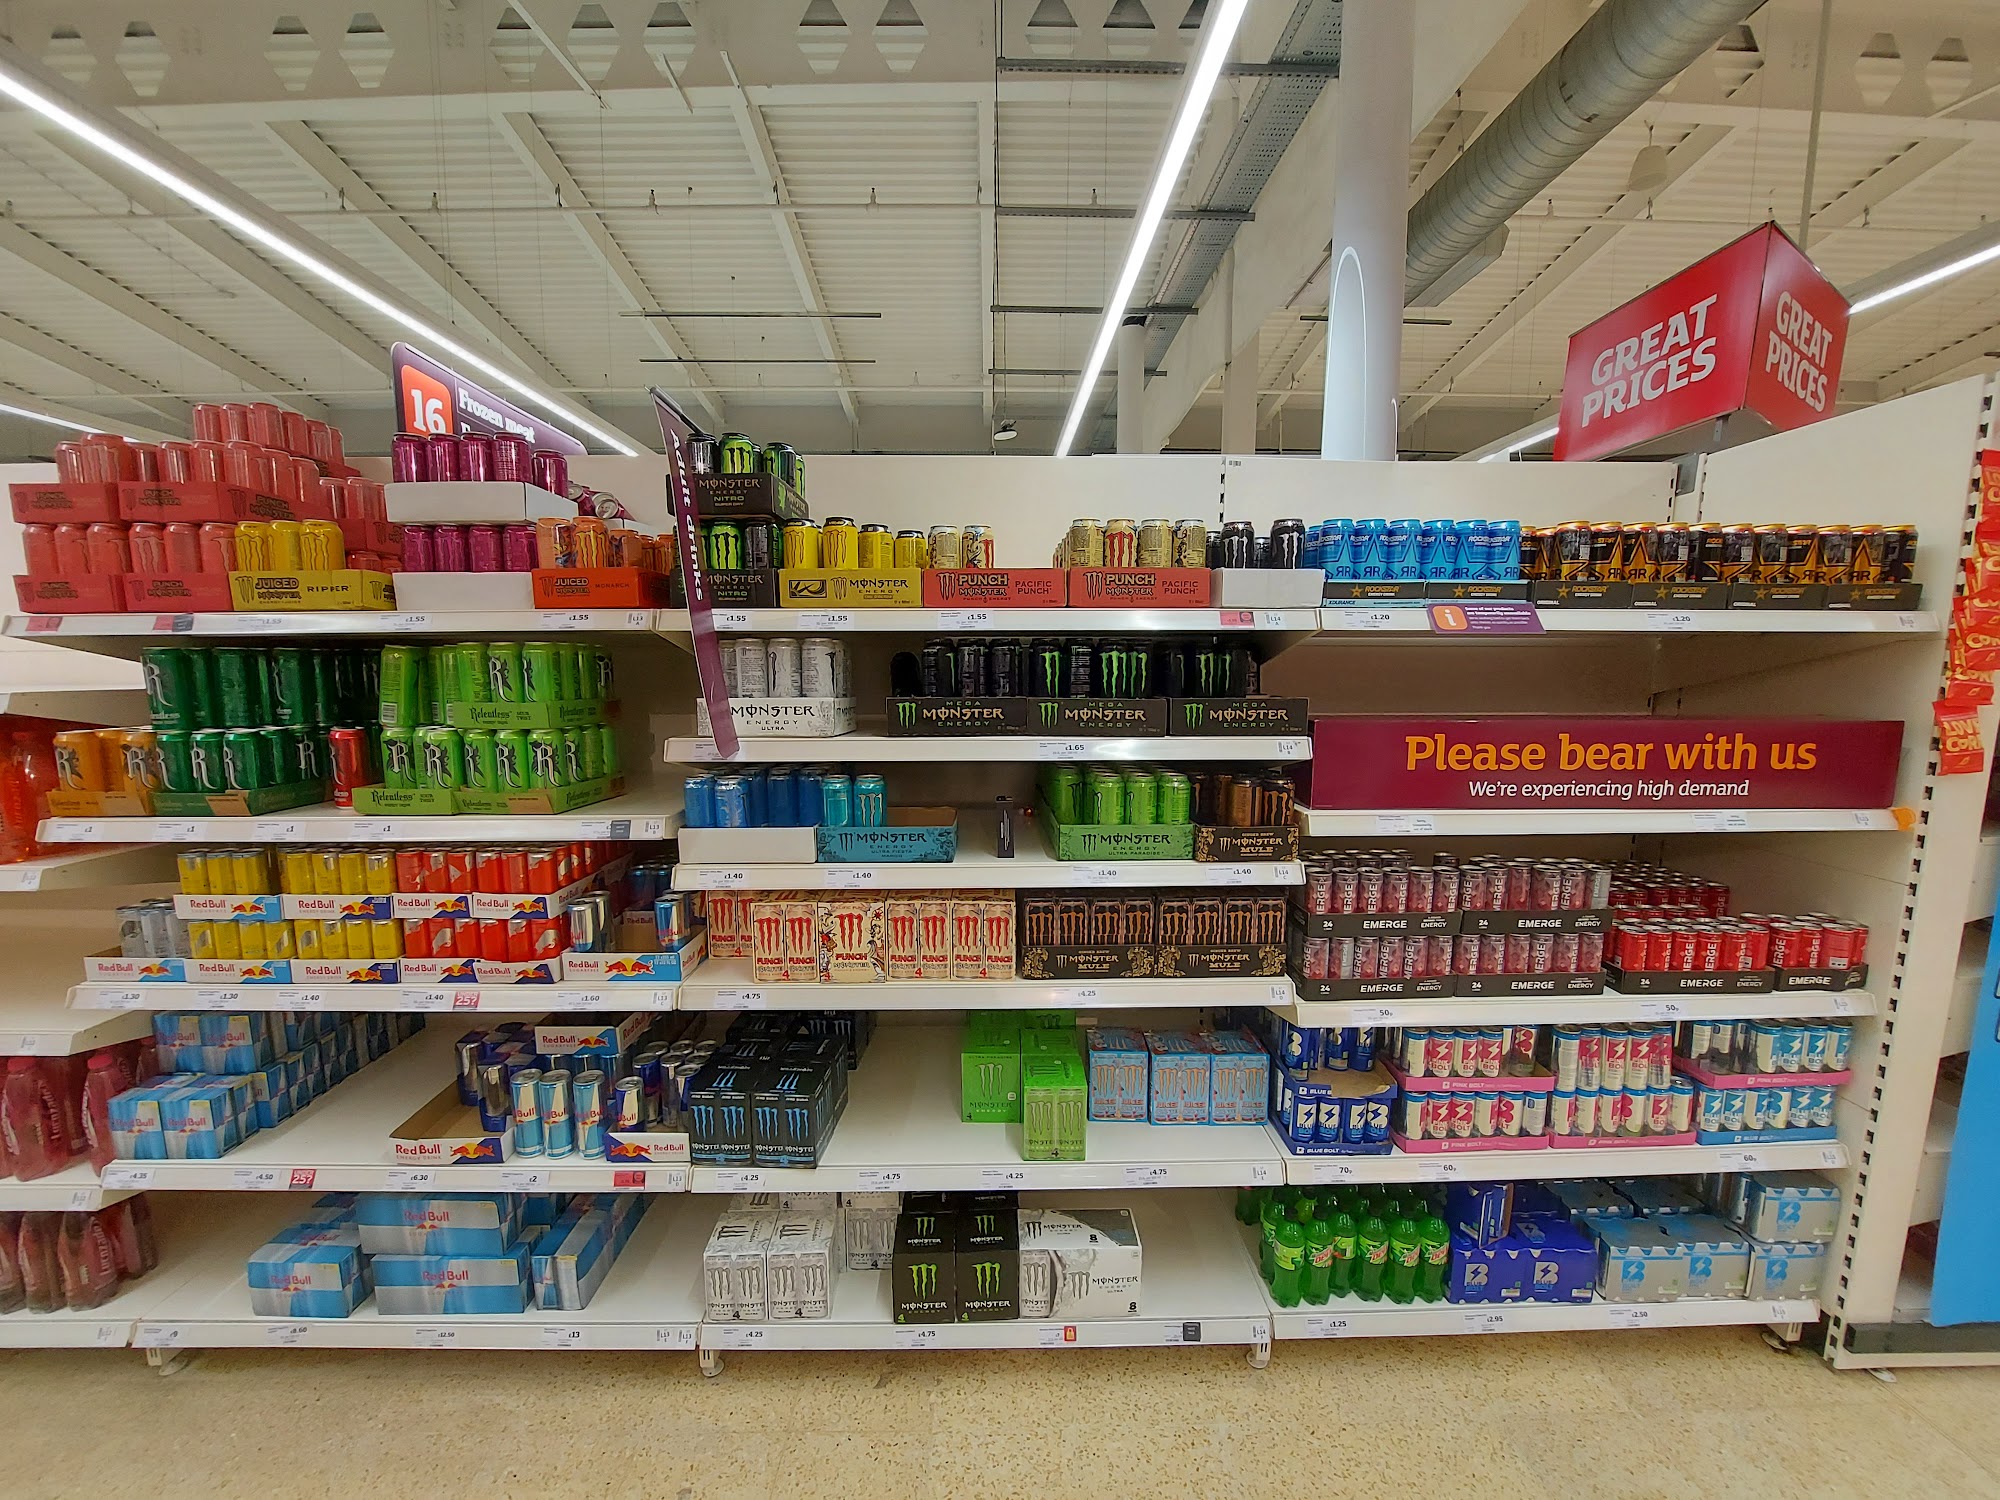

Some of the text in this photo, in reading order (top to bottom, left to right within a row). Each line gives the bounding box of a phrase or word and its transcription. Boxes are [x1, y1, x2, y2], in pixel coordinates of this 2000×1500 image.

[1776, 291, 1832, 369] GREAT
[1591, 294, 1717, 386] GREAT
[1765, 330, 1828, 413] PRICES
[1582, 337, 1716, 428] PRICES
[411, 388, 446, 434] 16
[459, 386, 536, 444] Frozen meat
[669, 428, 701, 600] Adult drinks
[255, 578, 299, 589] JUICED
[554, 578, 589, 586] JUICED
[958, 572, 1008, 585] PUNCH
[1105, 572, 1155, 585] PUNCH
[850, 579, 909, 589] MONSTER
[1770, 587, 1806, 595] ROCKSTAR
[469, 707, 510, 724] Relentless
[731, 705, 815, 717] MONSTER
[923, 707, 1004, 720] MONSTER
[1064, 709, 1146, 721] MONSTER
[1209, 709, 1288, 721] MONSTER
[1405, 732, 1817, 771] Please bear with us
[1469, 779, 1749, 800] We're experiencing high demand
[371, 790, 413, 806] Relentless
[856, 832, 927, 842] MONSTER
[1100, 834, 1171, 844] MONSTER
[1363, 920, 1407, 929] EMERGE
[1518, 919, 1562, 928] EMERGE
[735, 947, 742, 956] 4
[757, 957, 783, 965] PUNCH
[1069, 954, 1119, 963] MONSTER
[782, 970, 789, 980] 4
[915, 967, 923, 977] 4
[979, 968, 987, 977] 4
[1511, 981, 1555, 990] EMERGE
[1680, 979, 1723, 988] EMERGE
[1788, 977, 1831, 986] EMERGE
[1360, 984, 1403, 993] EMERGE
[456, 996, 478, 1006] 25?
[1379, 1009, 1393, 1017] 50p
[1665, 1004, 1679, 1012] 50p
[1743, 1154, 1757, 1162] 60p
[292, 1174, 312, 1184] 25?
[529, 1175, 538, 1183] £2
[1089, 1233, 1097, 1241] 8
[1092, 1276, 1138, 1285] MONSTER
[965, 1300, 1011, 1308] MONSTER
[1128, 1301, 1137, 1311] 8
[733, 1310, 741, 1320] 4
[795, 1308, 803, 1317] 4
[961, 1312, 968, 1321] 4
[569, 1331, 580, 1339] £13
